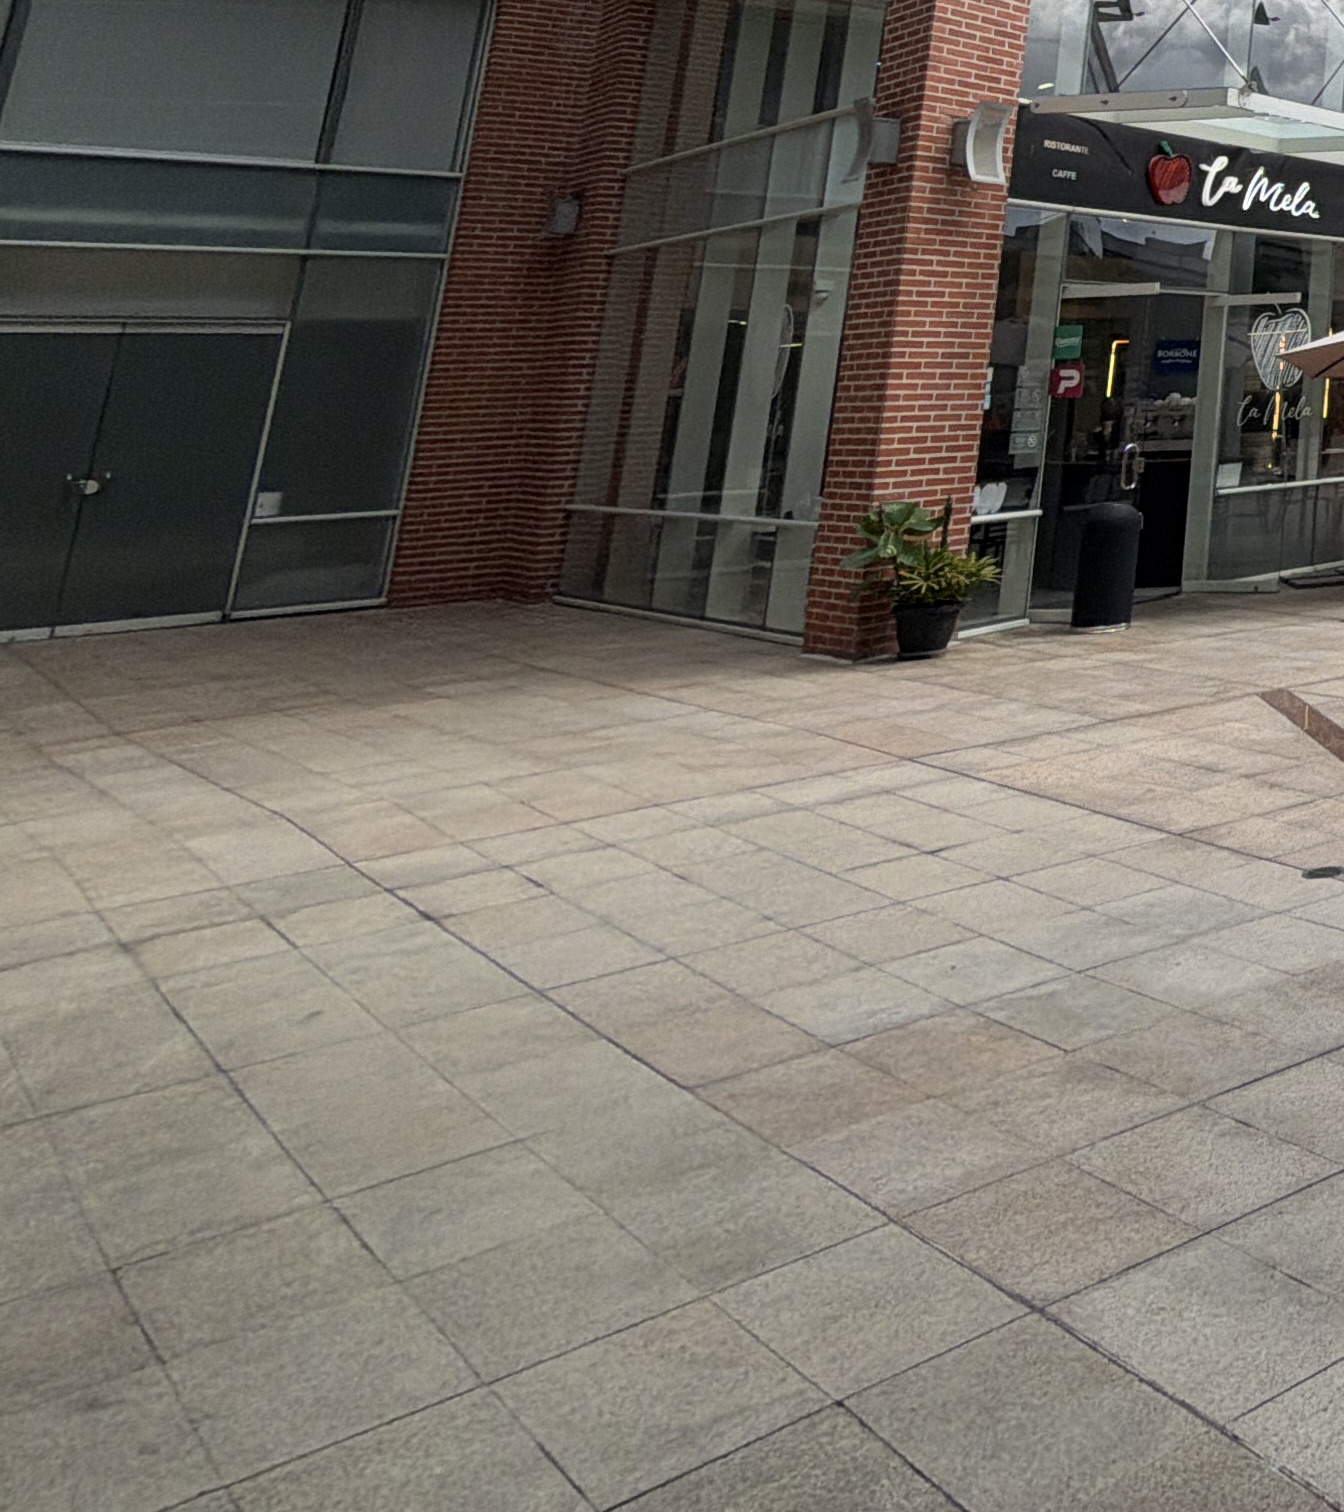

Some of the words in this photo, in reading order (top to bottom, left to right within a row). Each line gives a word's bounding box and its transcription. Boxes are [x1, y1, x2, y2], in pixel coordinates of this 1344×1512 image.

[1043, 139, 1089, 155] RISTORANTE
[1198, 155, 1243, 207] La
[1242, 165, 1320, 219] Mela
[1236, 394, 1261, 427] La
